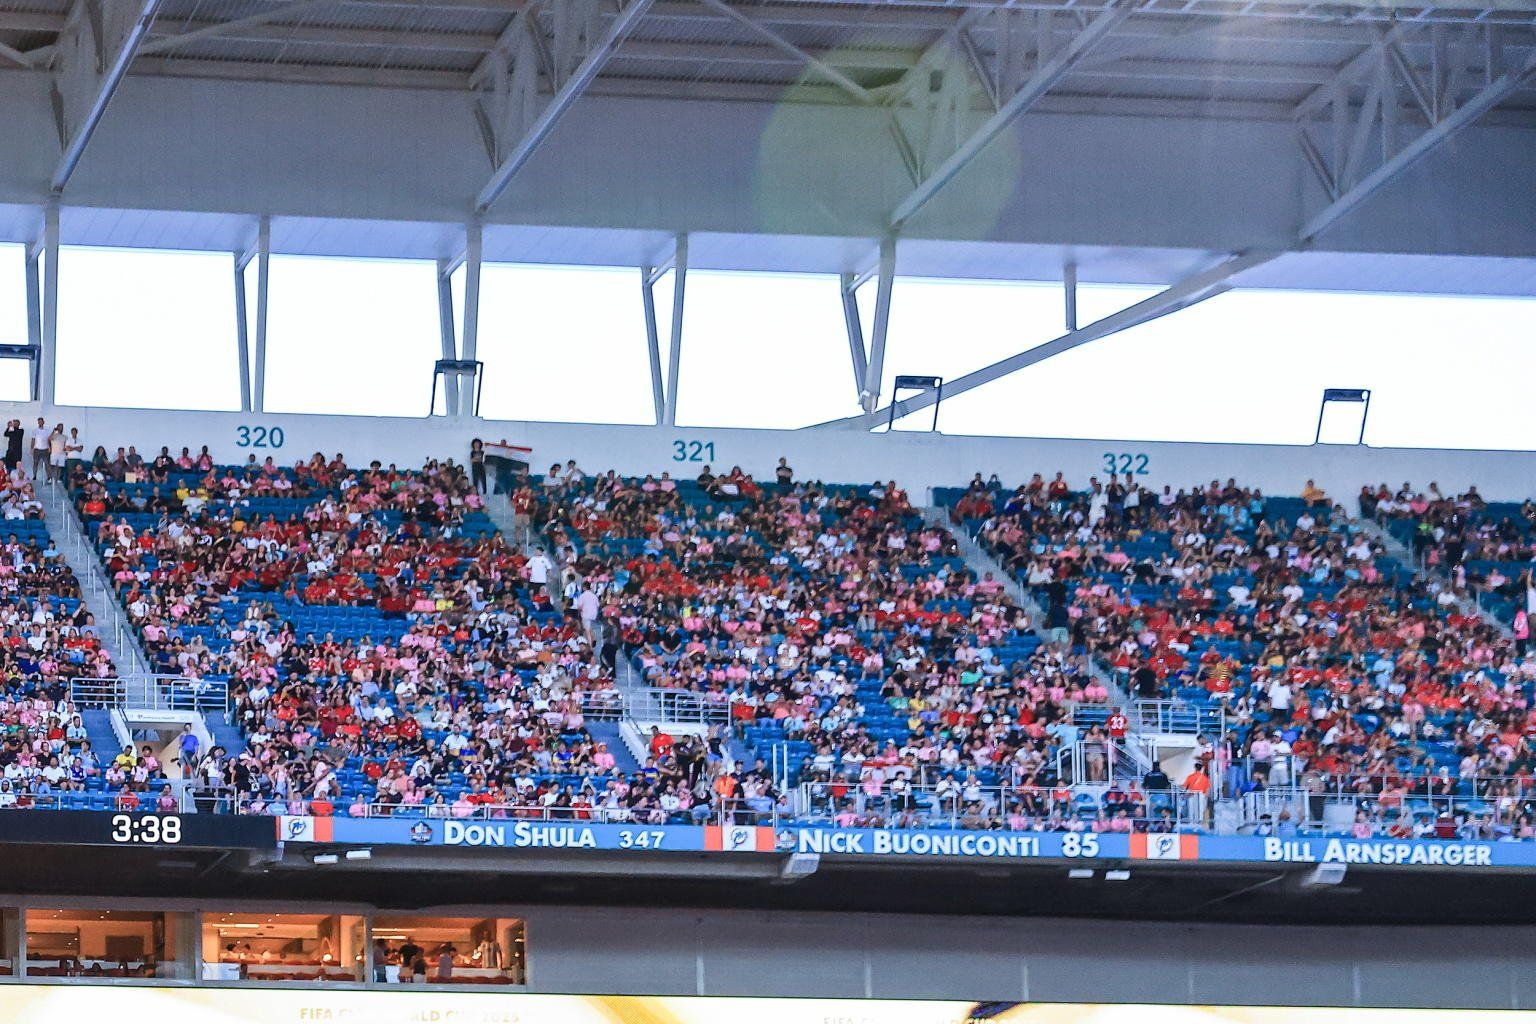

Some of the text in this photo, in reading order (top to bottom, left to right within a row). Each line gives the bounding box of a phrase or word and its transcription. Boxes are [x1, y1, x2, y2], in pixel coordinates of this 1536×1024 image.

[236, 426, 284, 448] 320
[672, 440, 715, 462] 321
[1102, 453, 1149, 476] 322
[111, 815, 181, 844] 3:38
[619, 831, 664, 849] 347
[1062, 832, 1100, 858] 85
[299, 1007, 333, 1020] FIFA
